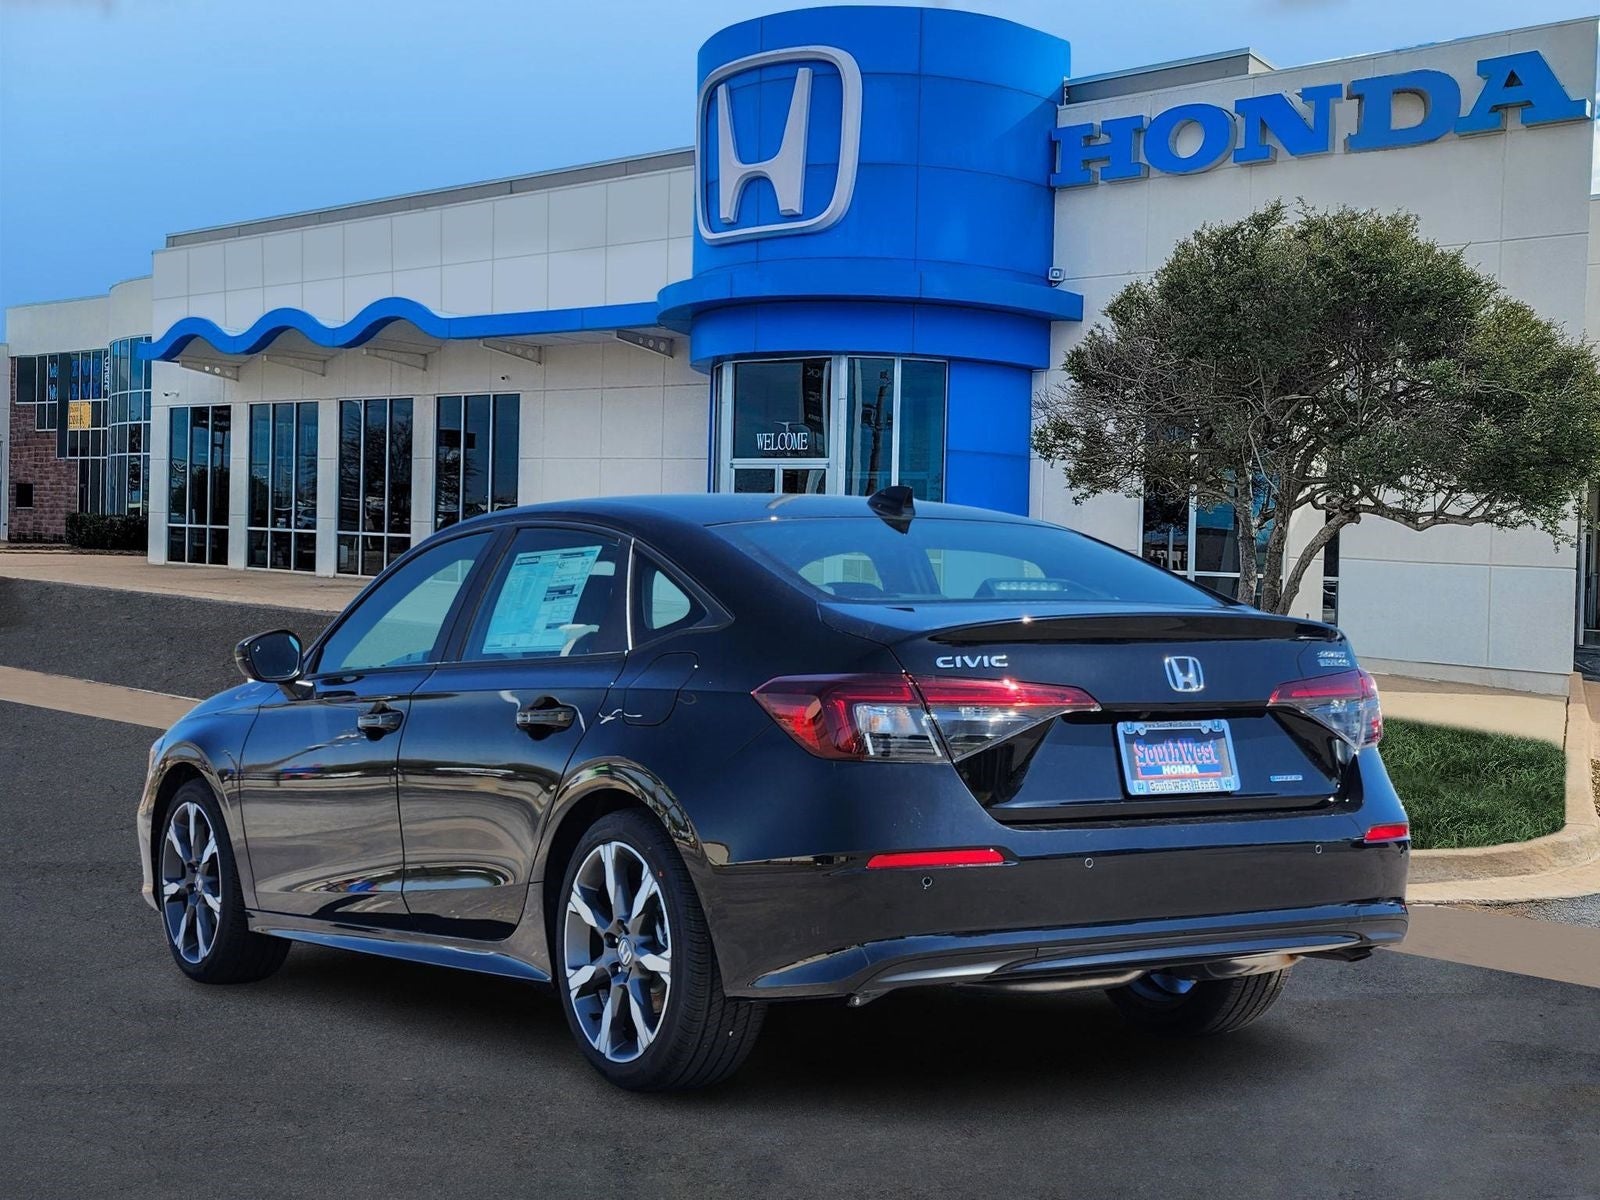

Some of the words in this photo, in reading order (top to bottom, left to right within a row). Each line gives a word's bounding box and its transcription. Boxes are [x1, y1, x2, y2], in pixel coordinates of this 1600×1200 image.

[1051, 50, 1592, 188] HONDA
[756, 433, 808, 451] WELCOME
[936, 655, 1008, 668] CIVIC
[1162, 764, 1199, 775] HONDA
